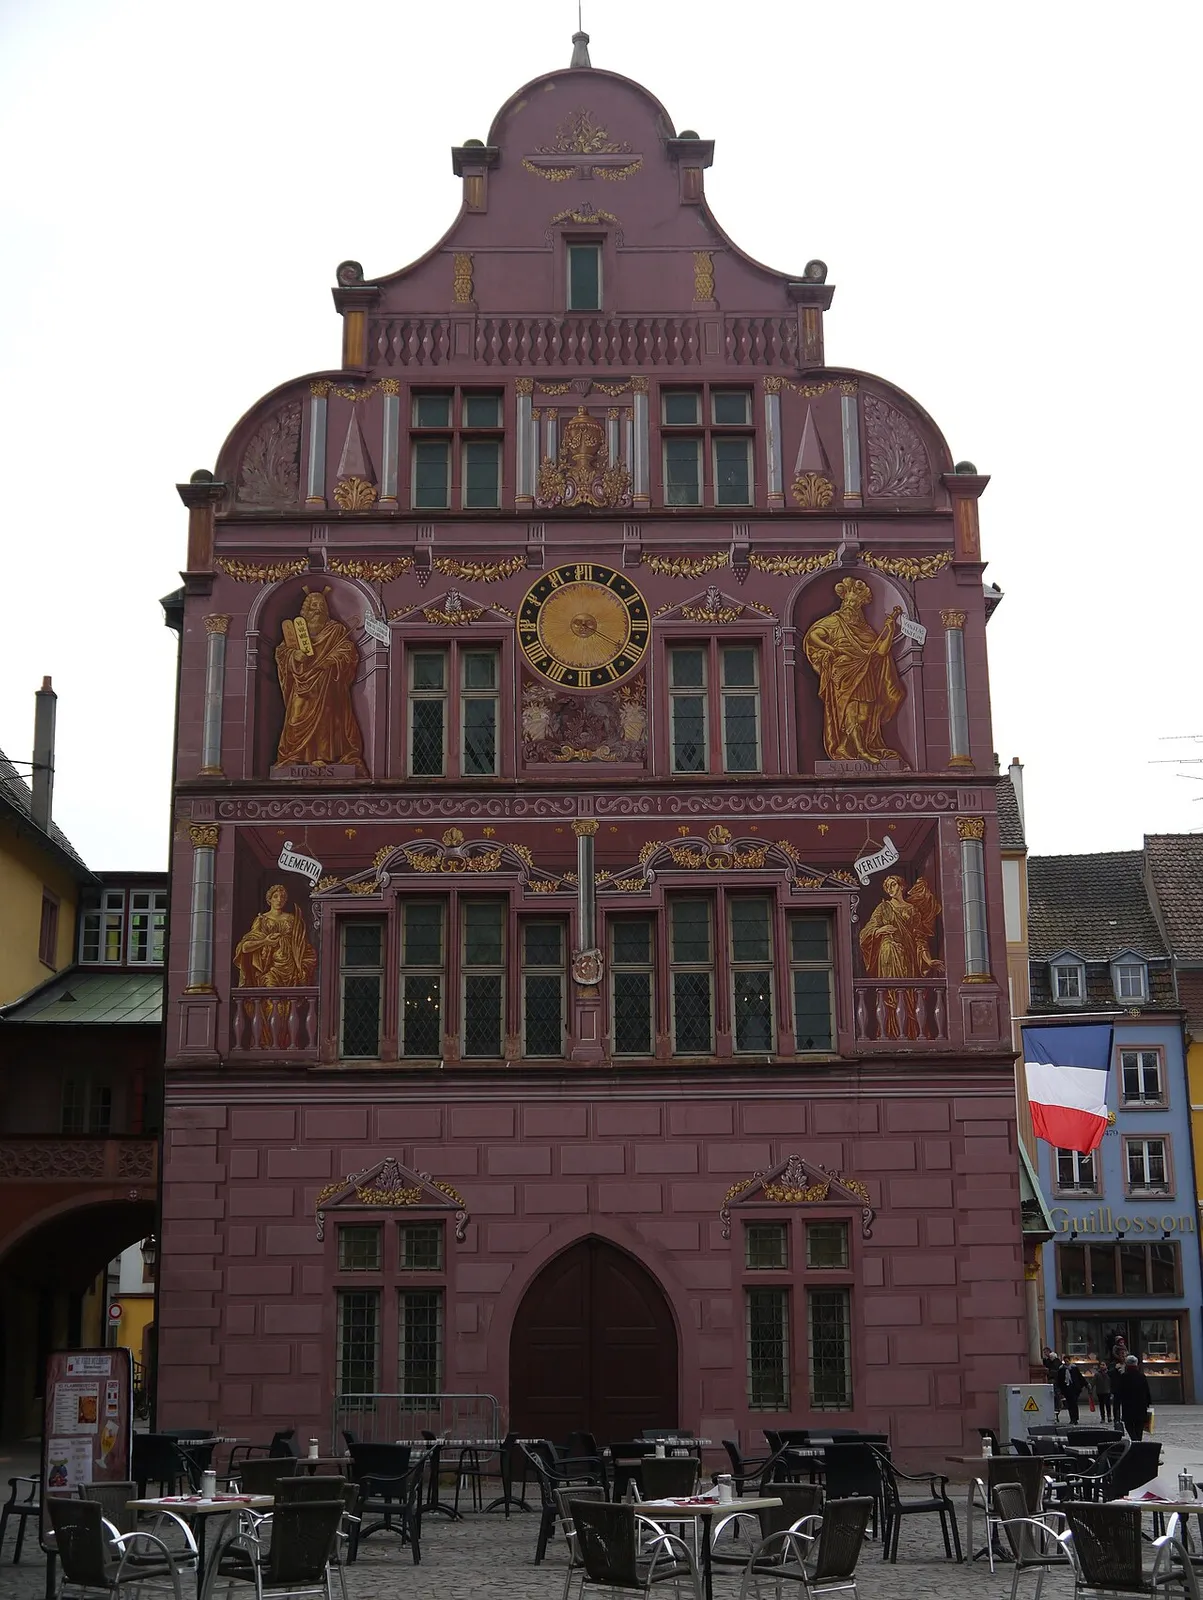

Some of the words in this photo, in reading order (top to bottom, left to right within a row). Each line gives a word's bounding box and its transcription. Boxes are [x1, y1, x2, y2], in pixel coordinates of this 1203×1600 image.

[289, 767, 335, 777] MOSES
[829, 762, 888, 773] SALOMON
[280, 853, 320, 878] CLEMENTIA
[856, 850, 893, 875] VERITAS
[1049, 1206, 1195, 1233] Guillosson
